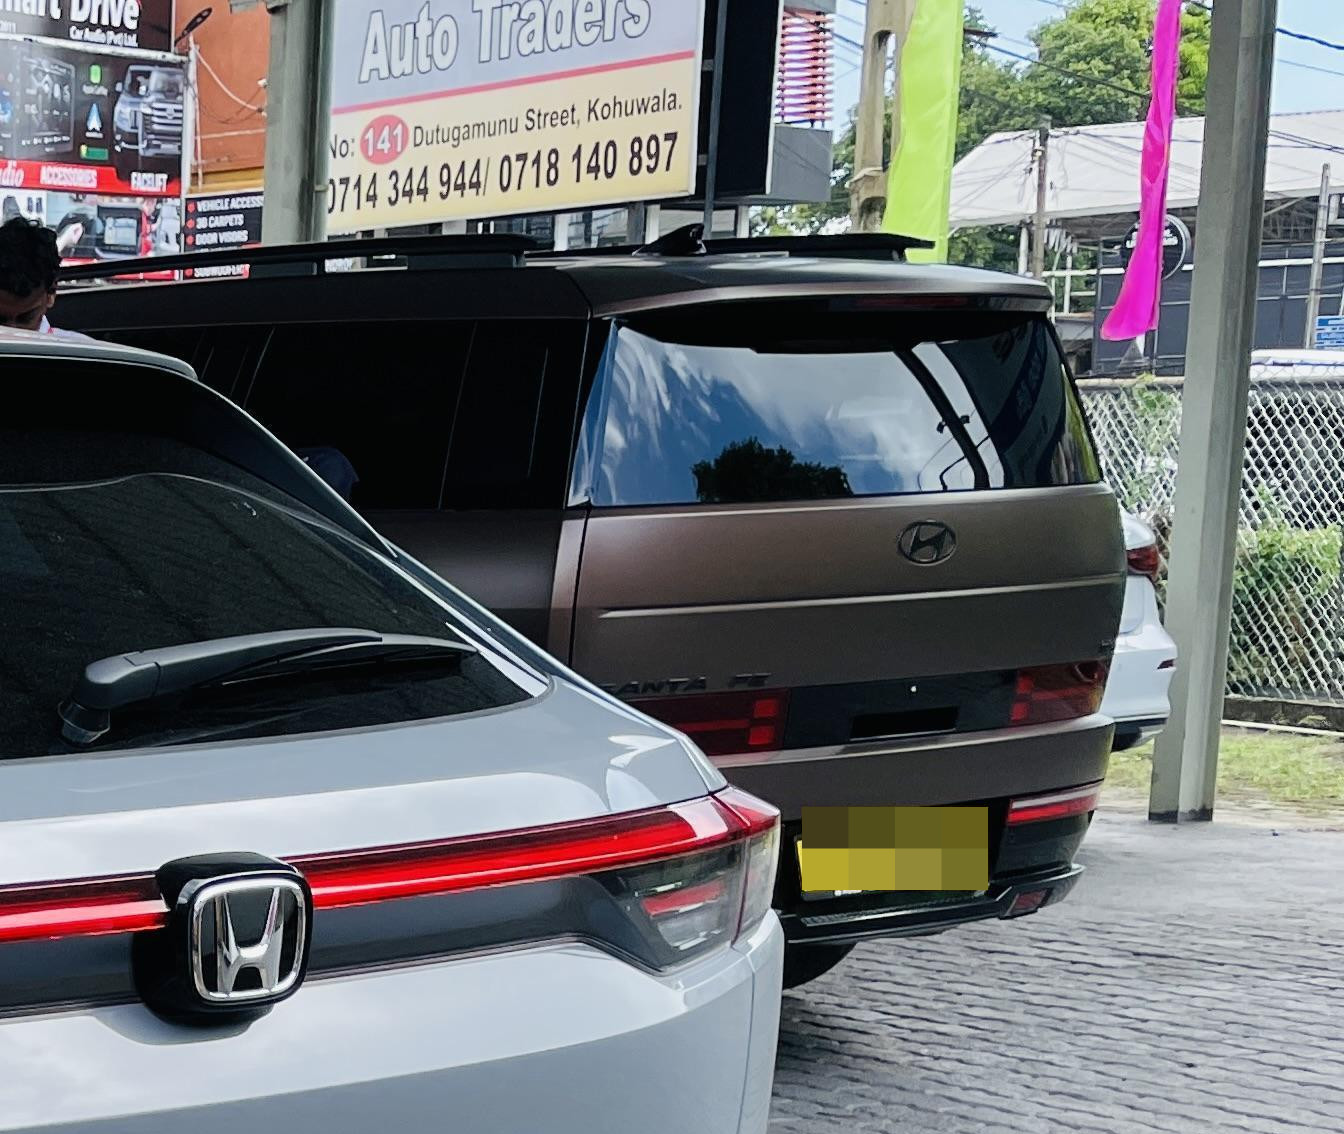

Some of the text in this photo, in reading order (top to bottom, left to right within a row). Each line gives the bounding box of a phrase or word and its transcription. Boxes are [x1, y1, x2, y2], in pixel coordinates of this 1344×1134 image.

[358, 0, 652, 84] Auto Traders
[363, 124, 407, 158] 141
[413, 112, 520, 149] Dutugamunu
[524, 102, 581, 131] Street,
[587, 88, 683, 123] Kohuwala.
[387, 164, 430, 208] 344
[438, 156, 491, 201] 944/
[499, 147, 560, 193] 0718
[571, 139, 618, 183] 140
[628, 131, 679, 177] 897
